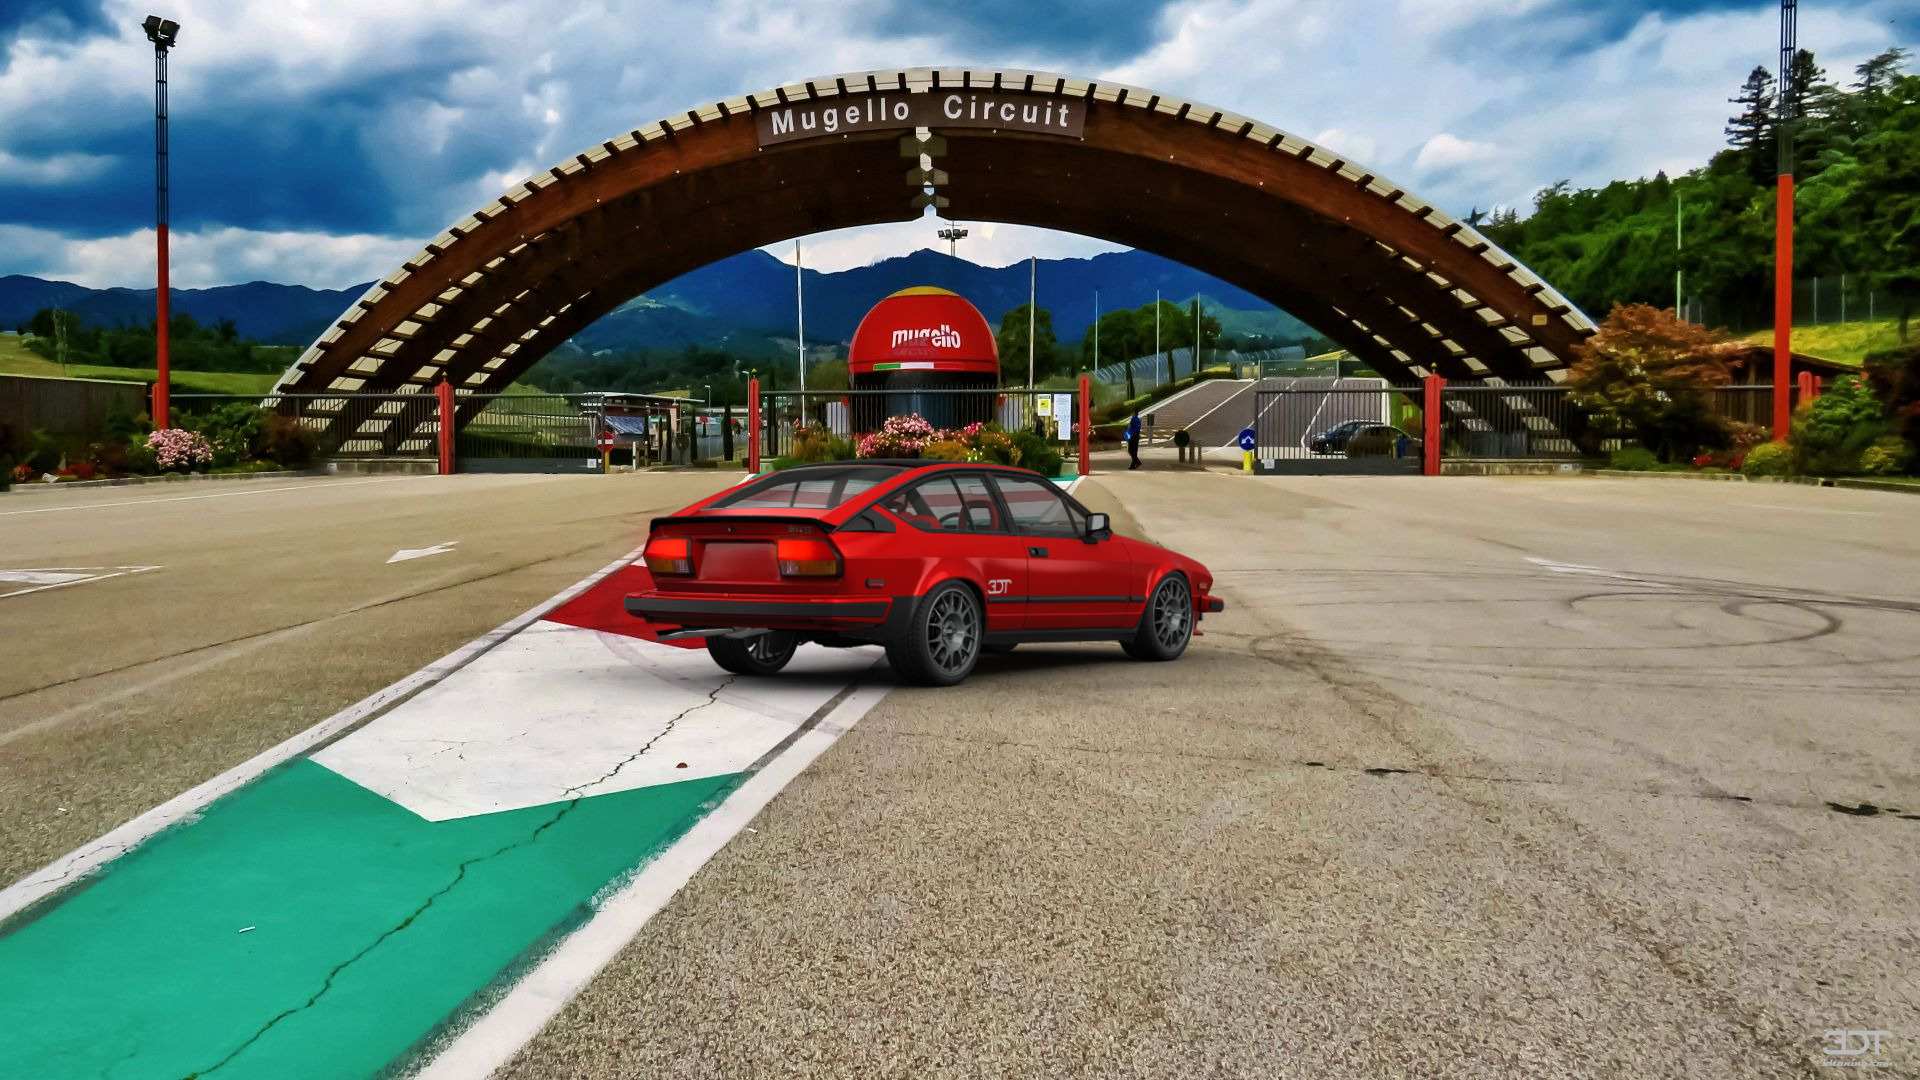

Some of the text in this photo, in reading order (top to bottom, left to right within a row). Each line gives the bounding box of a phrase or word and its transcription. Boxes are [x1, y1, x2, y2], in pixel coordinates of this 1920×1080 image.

[771, 95, 1070, 135] Mugello Circuit
[891, 324, 961, 349] mugello
[988, 579, 1012, 594] 3DT
